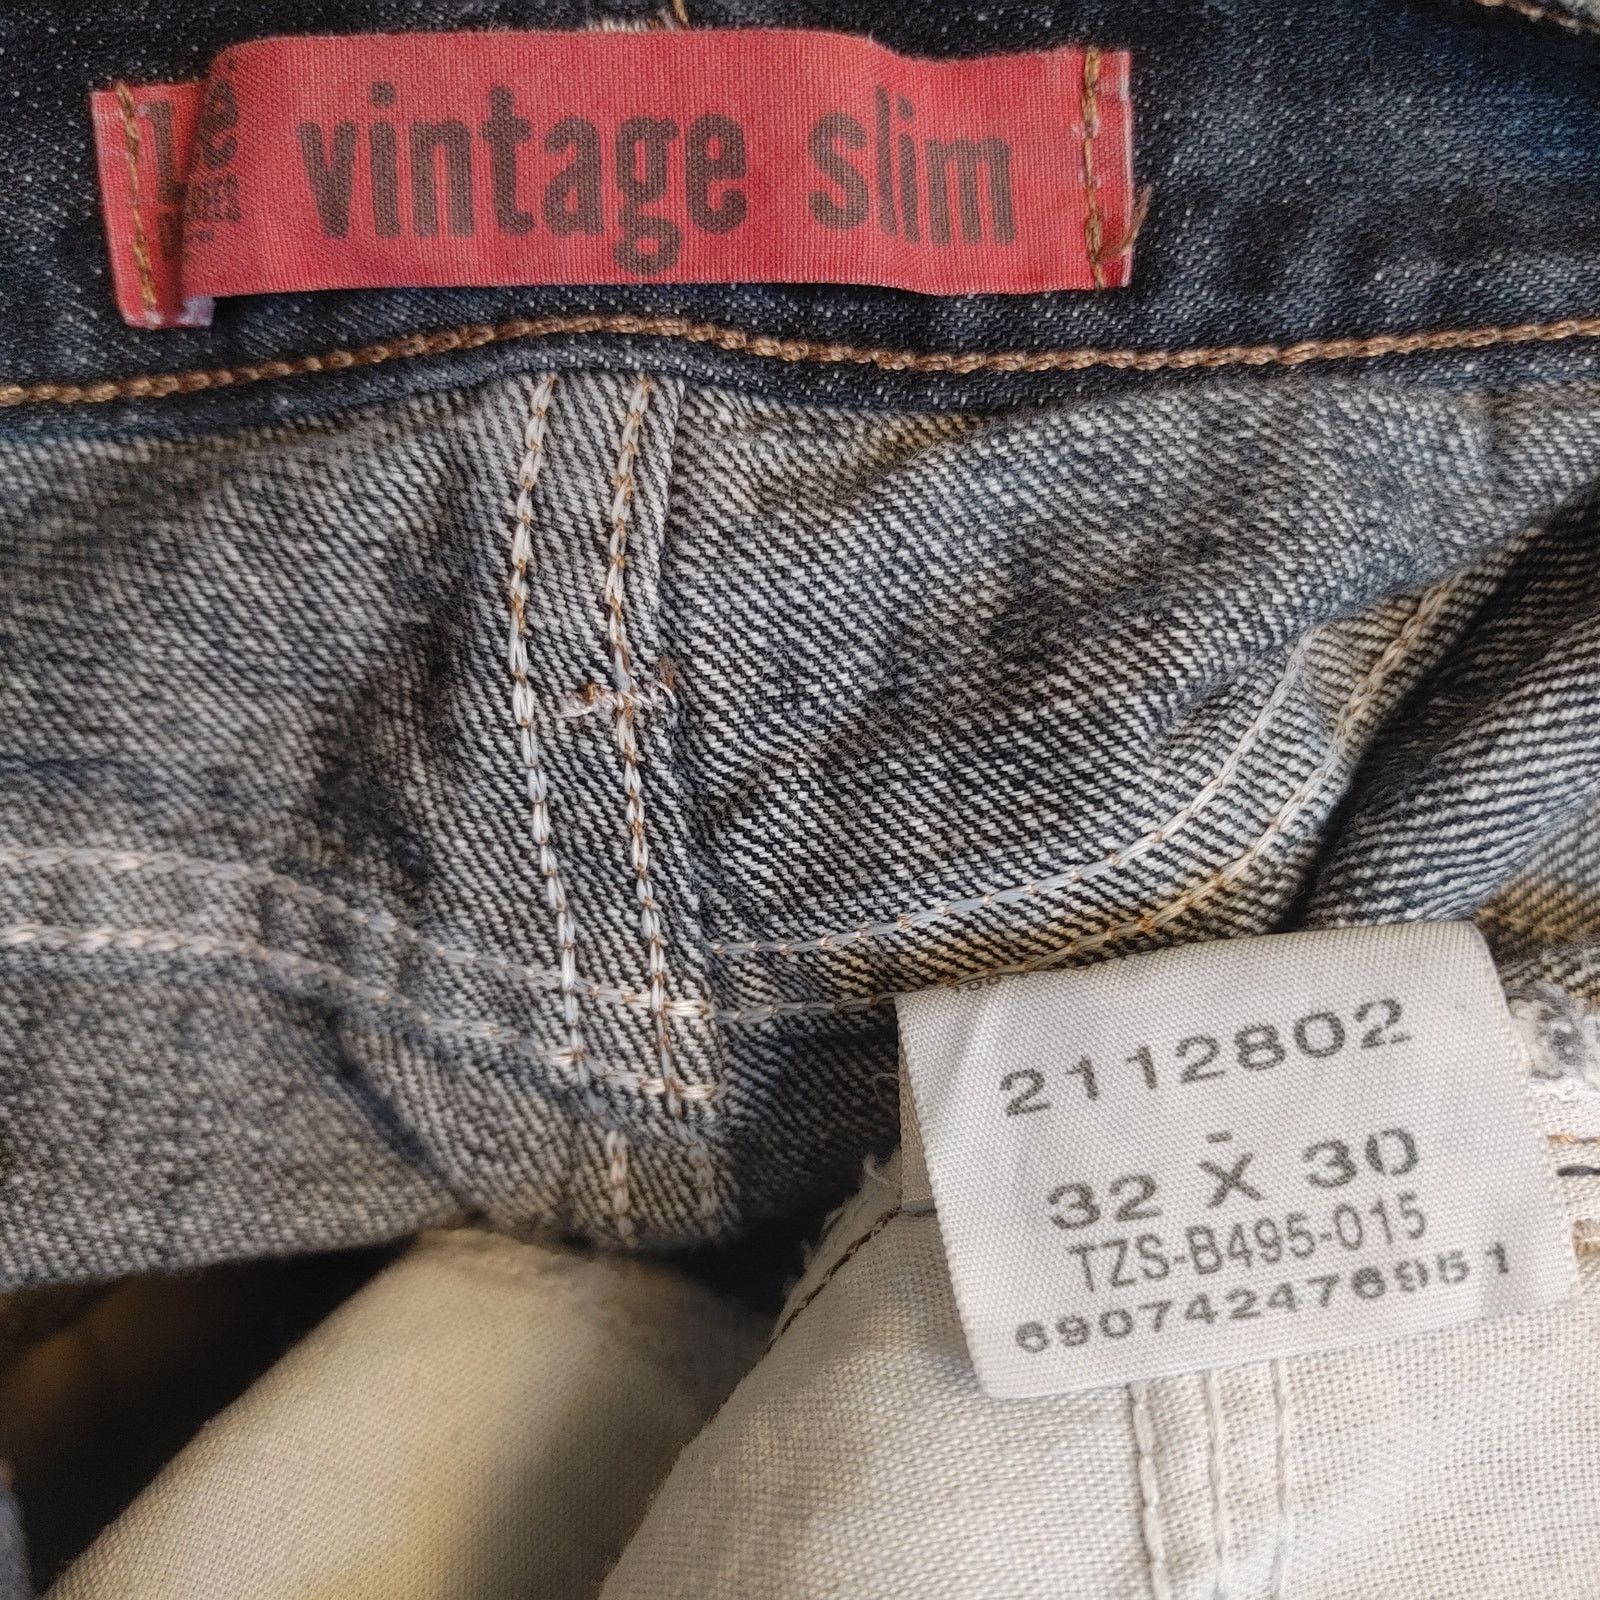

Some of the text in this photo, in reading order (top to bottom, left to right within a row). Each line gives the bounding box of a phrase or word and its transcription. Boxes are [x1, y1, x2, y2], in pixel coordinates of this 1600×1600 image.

[296, 82, 748, 275] vintage
[807, 85, 1017, 246] slim
[999, 998, 1411, 1117] 2112802
[1046, 1174, 1163, 1230] 32
[1302, 1127, 1419, 1188] 30
[1069, 1194, 1428, 1292] TZS-B495-015
